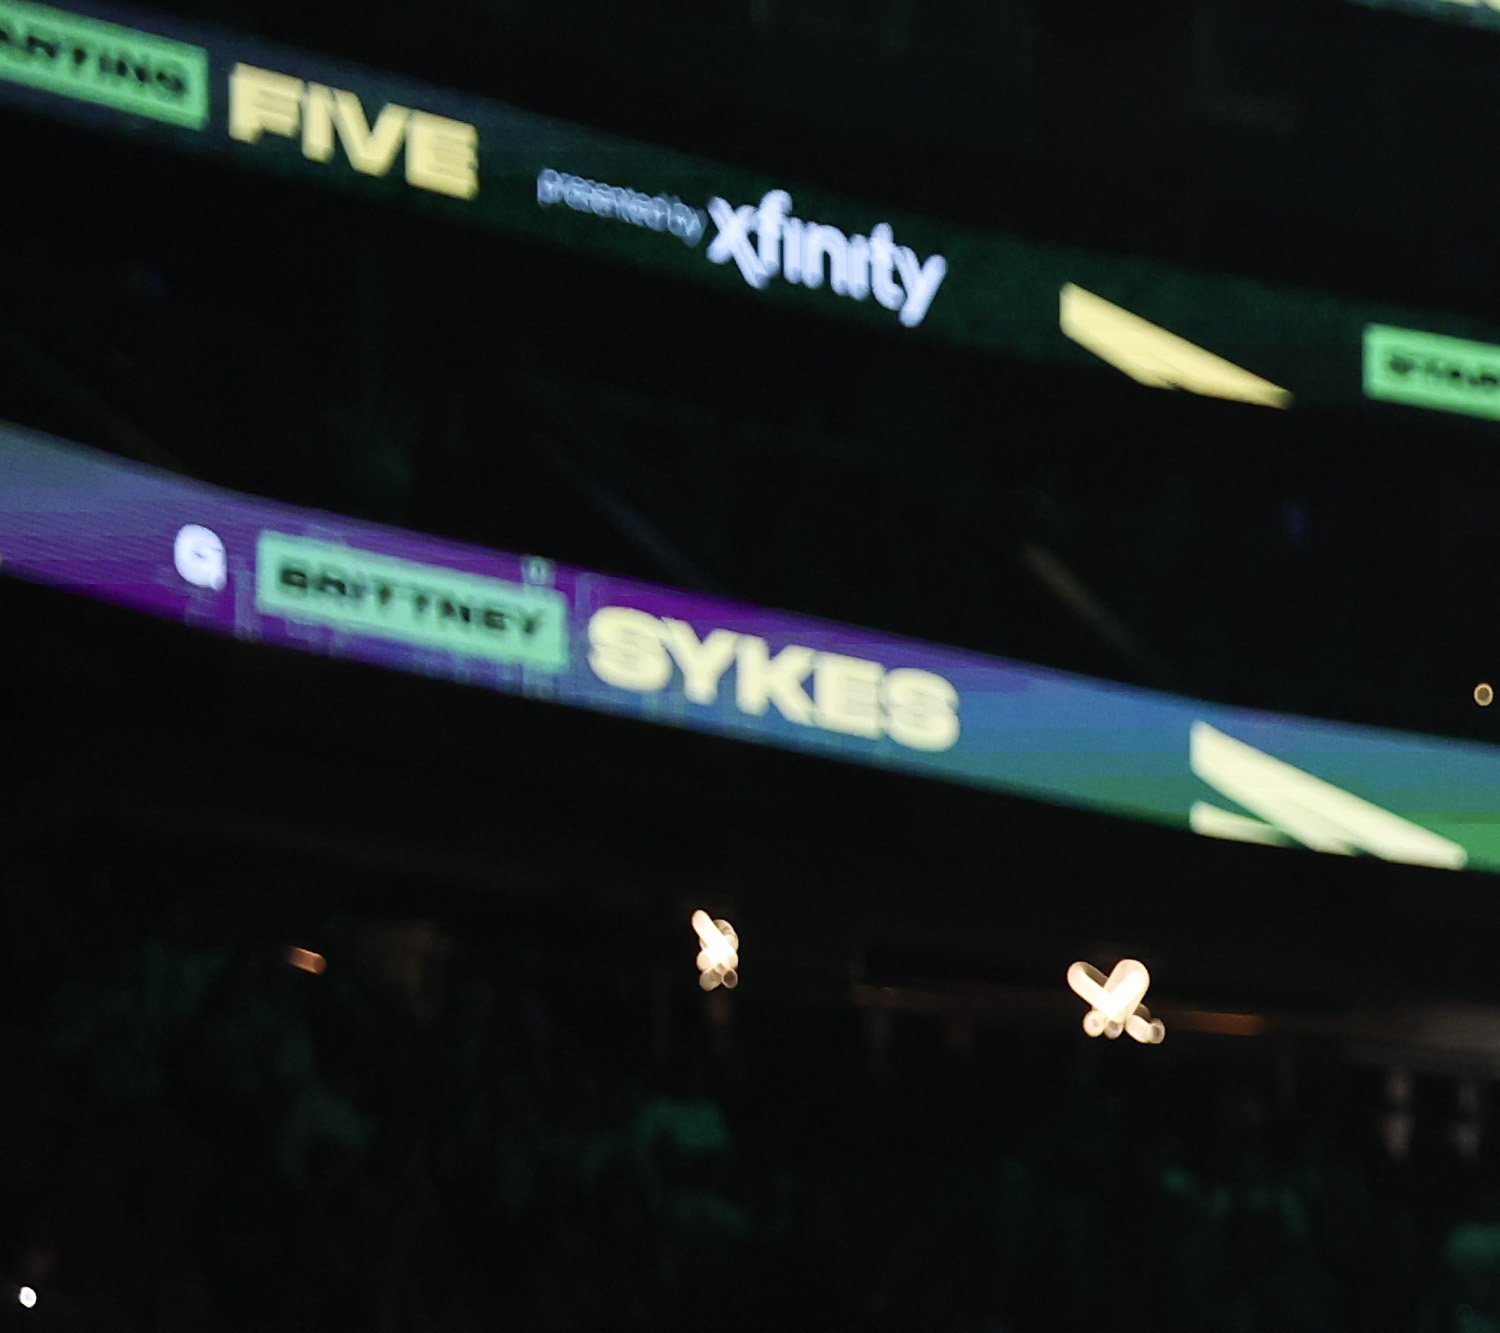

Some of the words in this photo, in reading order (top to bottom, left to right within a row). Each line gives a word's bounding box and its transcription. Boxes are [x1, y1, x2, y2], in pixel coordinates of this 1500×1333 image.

[228, 61, 479, 200] FIVE
[706, 188, 948, 328] xfinity
[278, 560, 543, 636] BRITTNEY
[587, 605, 961, 752] SYKES
